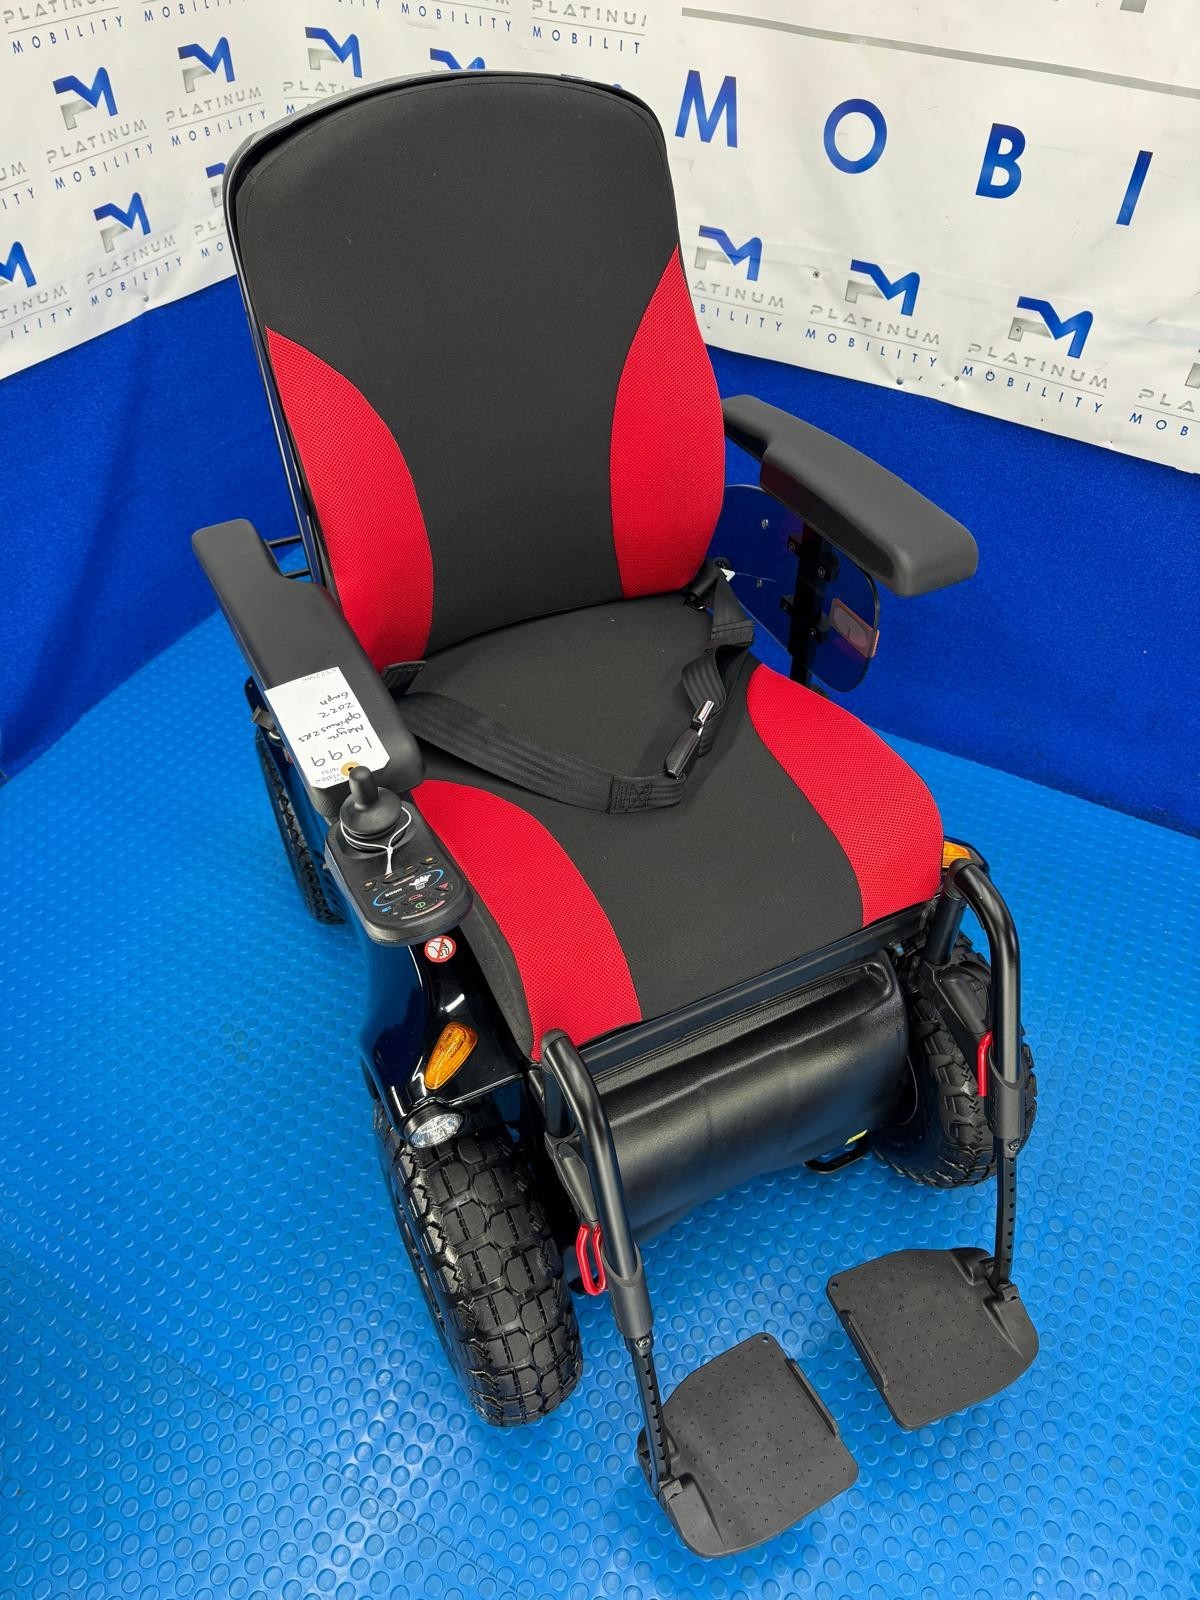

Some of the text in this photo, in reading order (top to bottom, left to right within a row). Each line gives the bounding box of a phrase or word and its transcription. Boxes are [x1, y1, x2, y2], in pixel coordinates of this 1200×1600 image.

[3, 0, 104, 24] PLATIN
[401, 2, 512, 32] MOBILITY
[12, 15, 122, 54] MOBILITY
[166, 87, 262, 122] PLATINUM
[46, 120, 147, 163] PLATINUM
[171, 109, 265, 146] MOBILITY
[55, 143, 153, 190] MOBILITY
[86, 235, 176, 285] PLATINUM
[91, 256, 183, 307] MOBILITY
[809, 304, 940, 345] PLATINUM
[804, 328, 937, 367] MOBILITY
[967, 343, 1108, 390] PLATINUM
[961, 365, 1103, 413] MOBILITY
[310, 736, 372, 767] 1999
